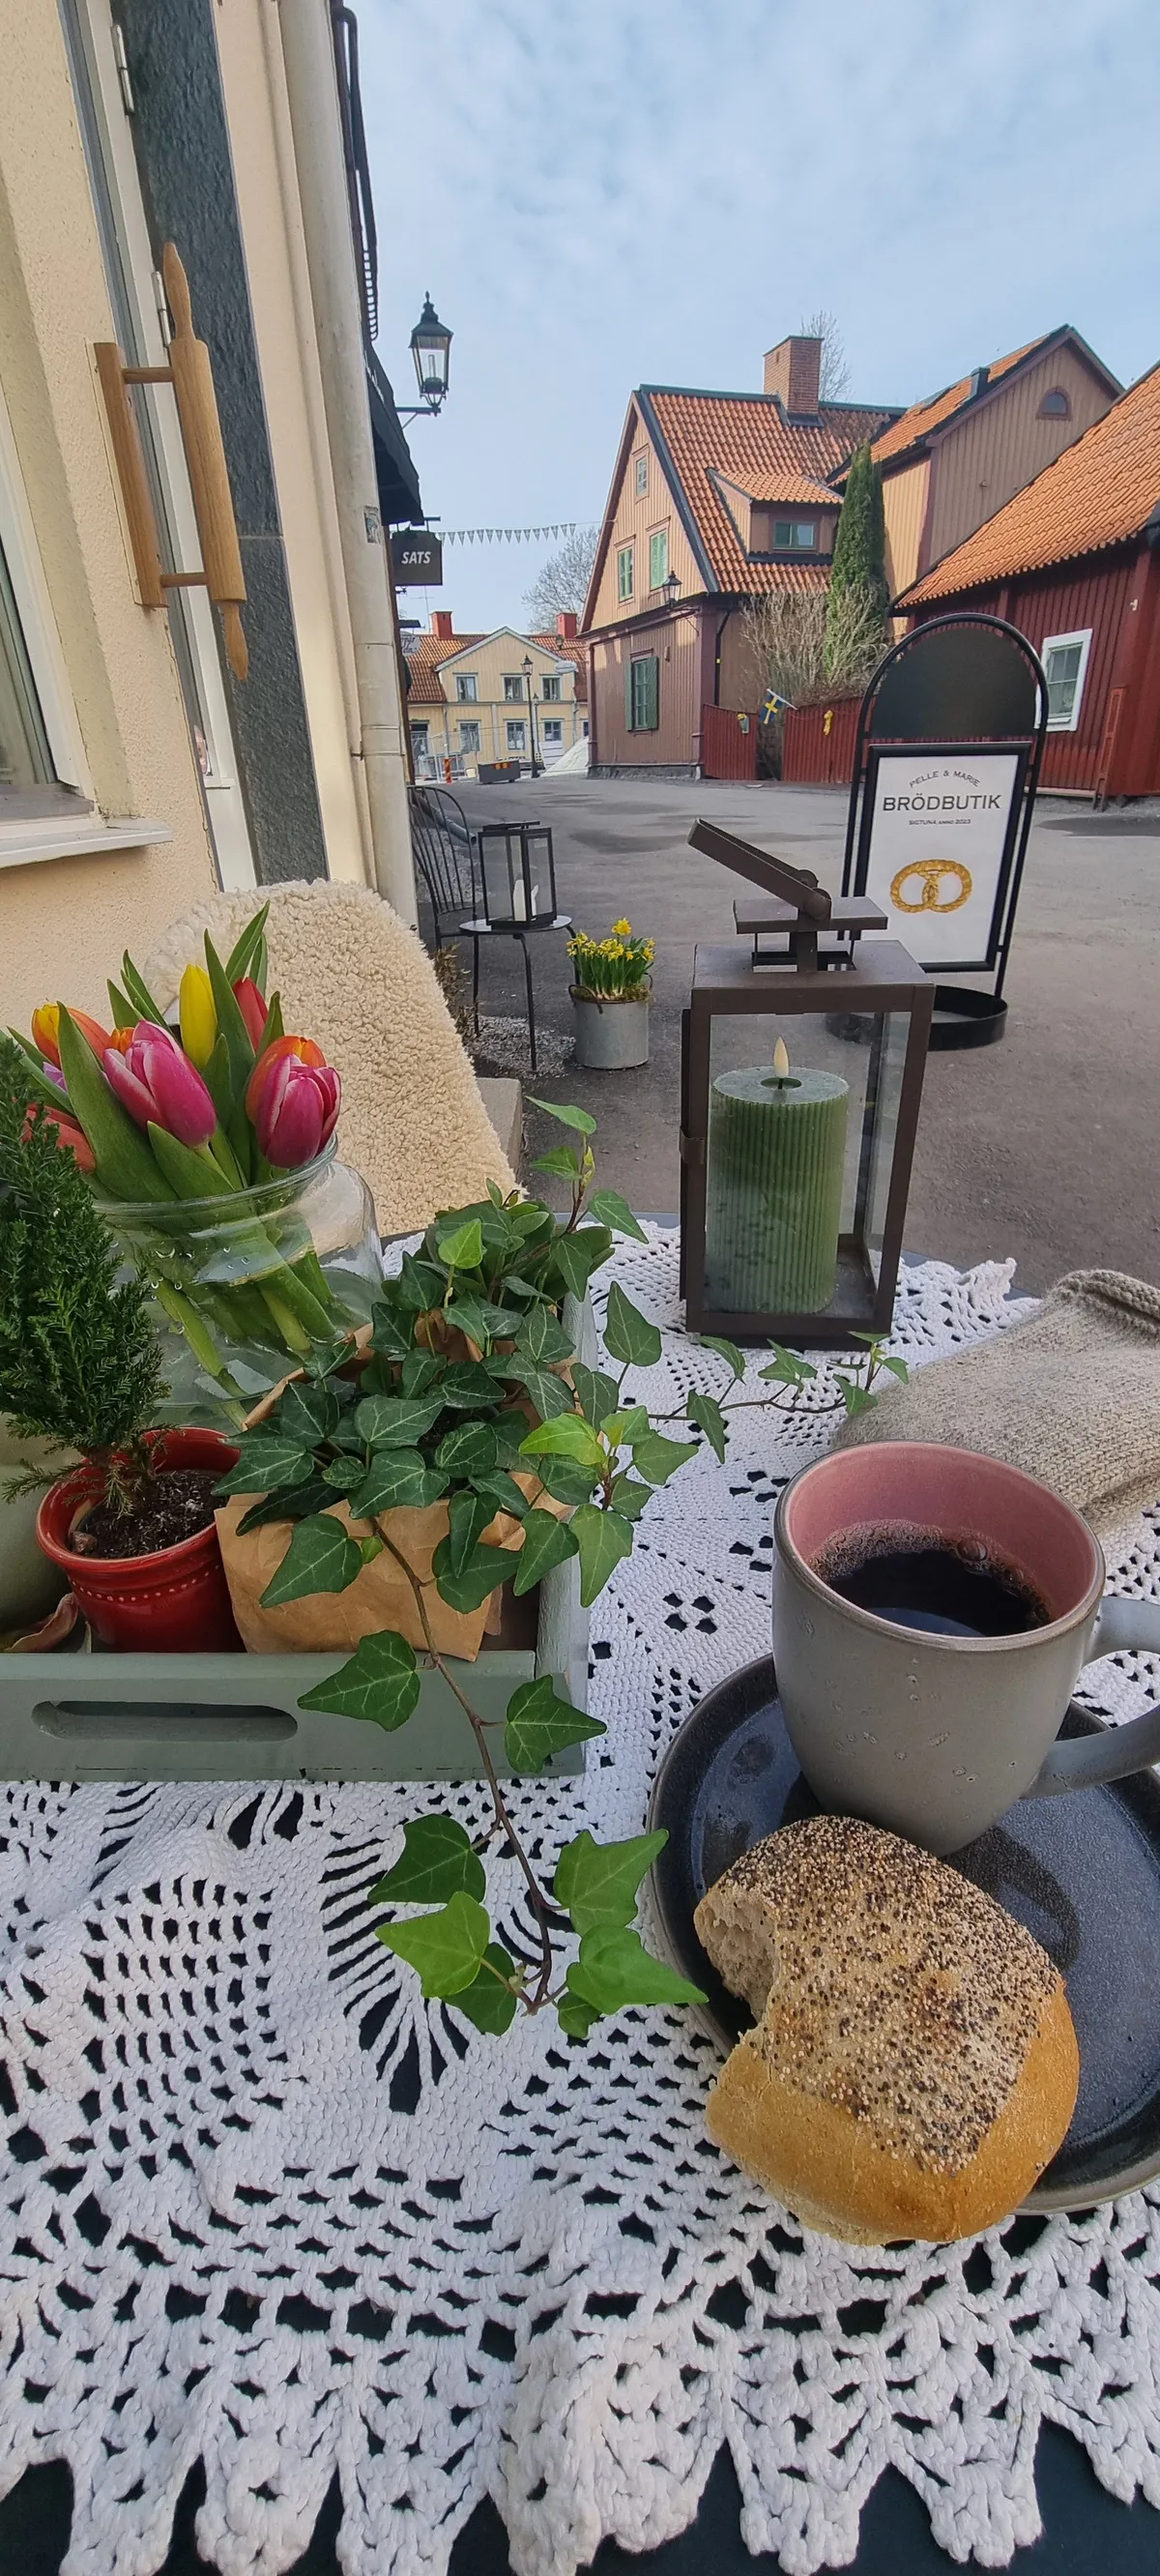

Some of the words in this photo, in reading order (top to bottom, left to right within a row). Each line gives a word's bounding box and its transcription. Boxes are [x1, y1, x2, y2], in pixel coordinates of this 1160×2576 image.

[401, 551, 431, 564] SATS
[909, 771, 939, 788] PELLE
[953, 771, 980, 787] MARIE
[883, 793, 1001, 811] BRÖDBUTIK
